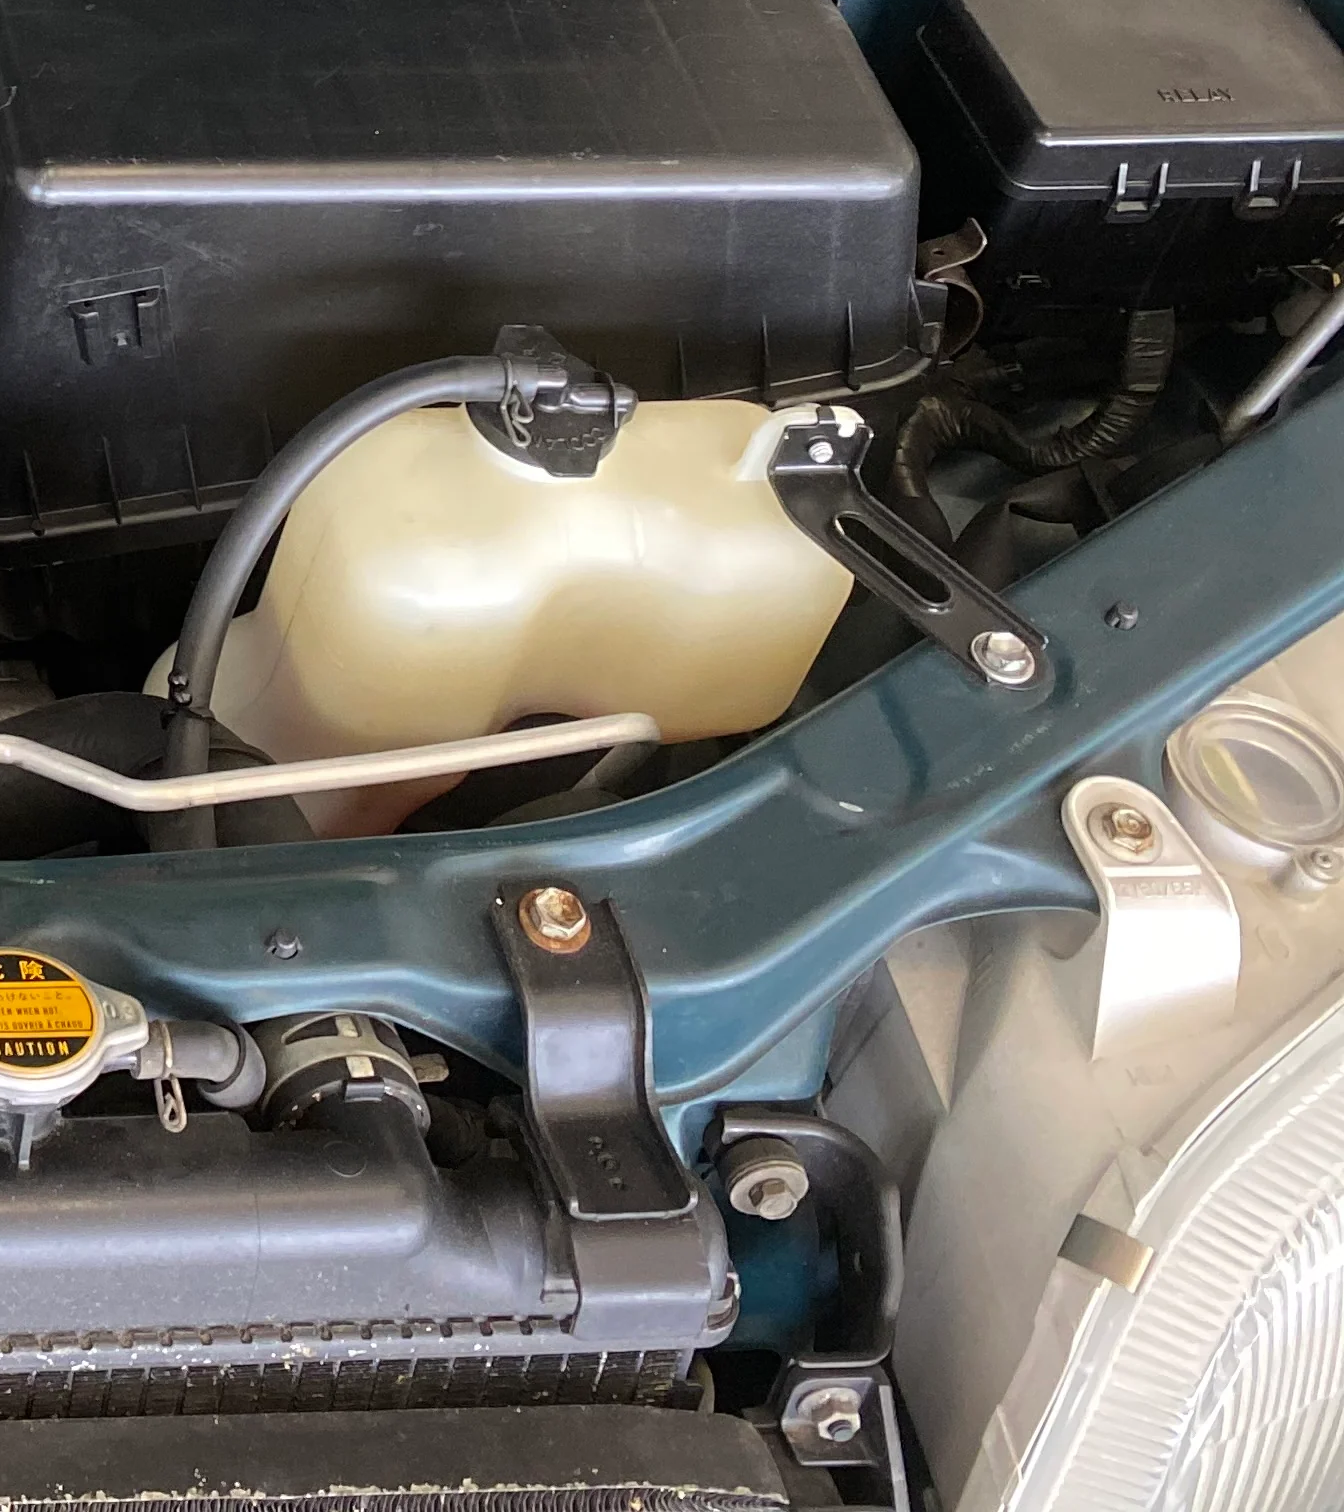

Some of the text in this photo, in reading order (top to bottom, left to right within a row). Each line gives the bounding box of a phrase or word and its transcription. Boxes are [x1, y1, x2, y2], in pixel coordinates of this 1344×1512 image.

[1156, 88, 1234, 103] RELAY
[16, 1006, 40, 1015] WHEN
[12, 1020, 45, 1030] OUVRIR
[55, 1019, 84, 1029] CHAUD
